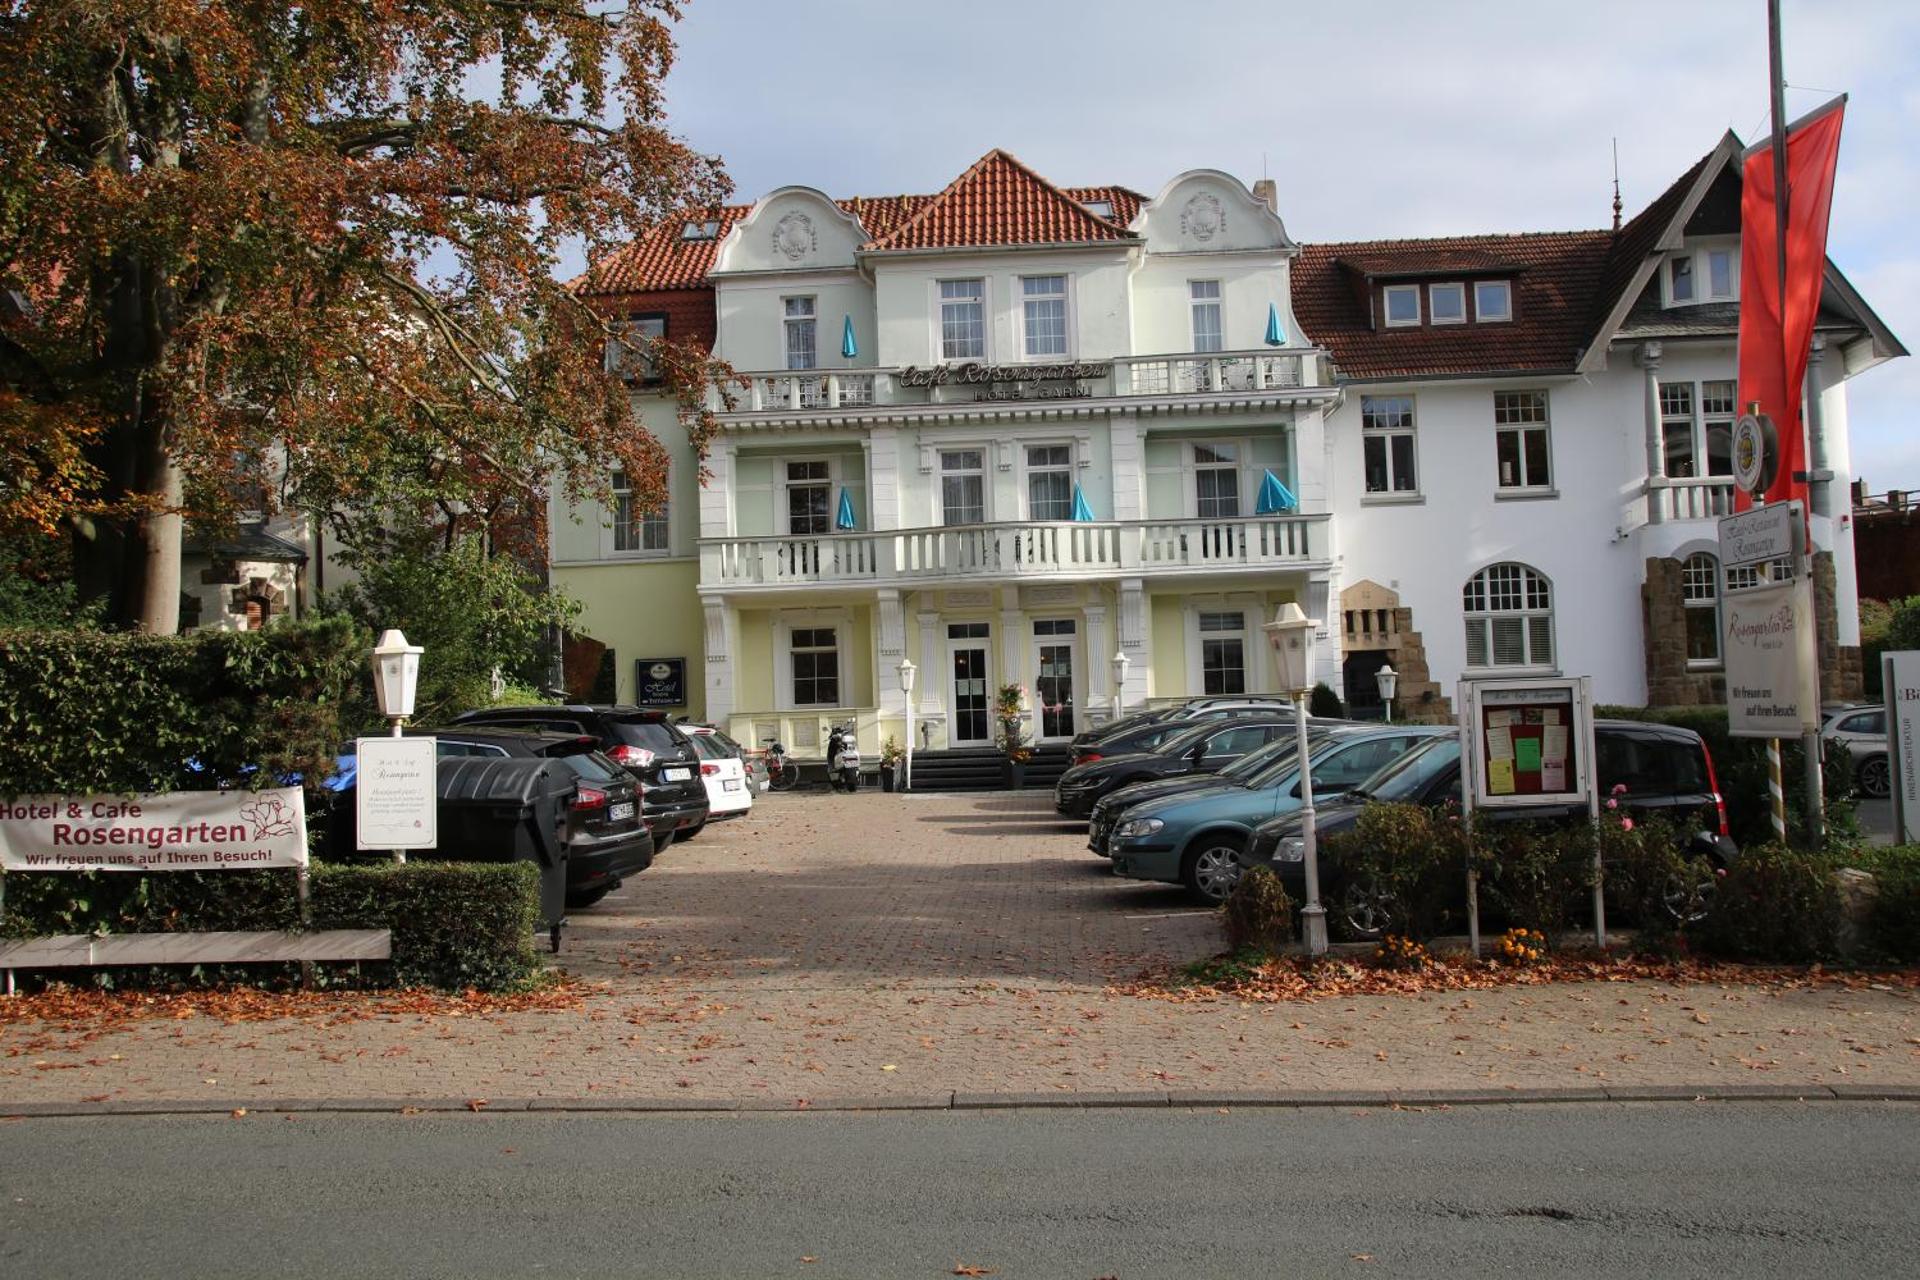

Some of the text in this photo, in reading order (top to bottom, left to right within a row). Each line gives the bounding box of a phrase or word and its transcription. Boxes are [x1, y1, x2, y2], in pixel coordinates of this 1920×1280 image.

[899, 360, 1110, 388] Café Rosengarten
[1038, 385, 1092, 399] GARNI
[0, 802, 142, 820] Hotel & Cafe
[53, 822, 247, 849] Rosengarten
[25, 850, 273, 866] Wir freuen uns auf Ihren Besuch!
